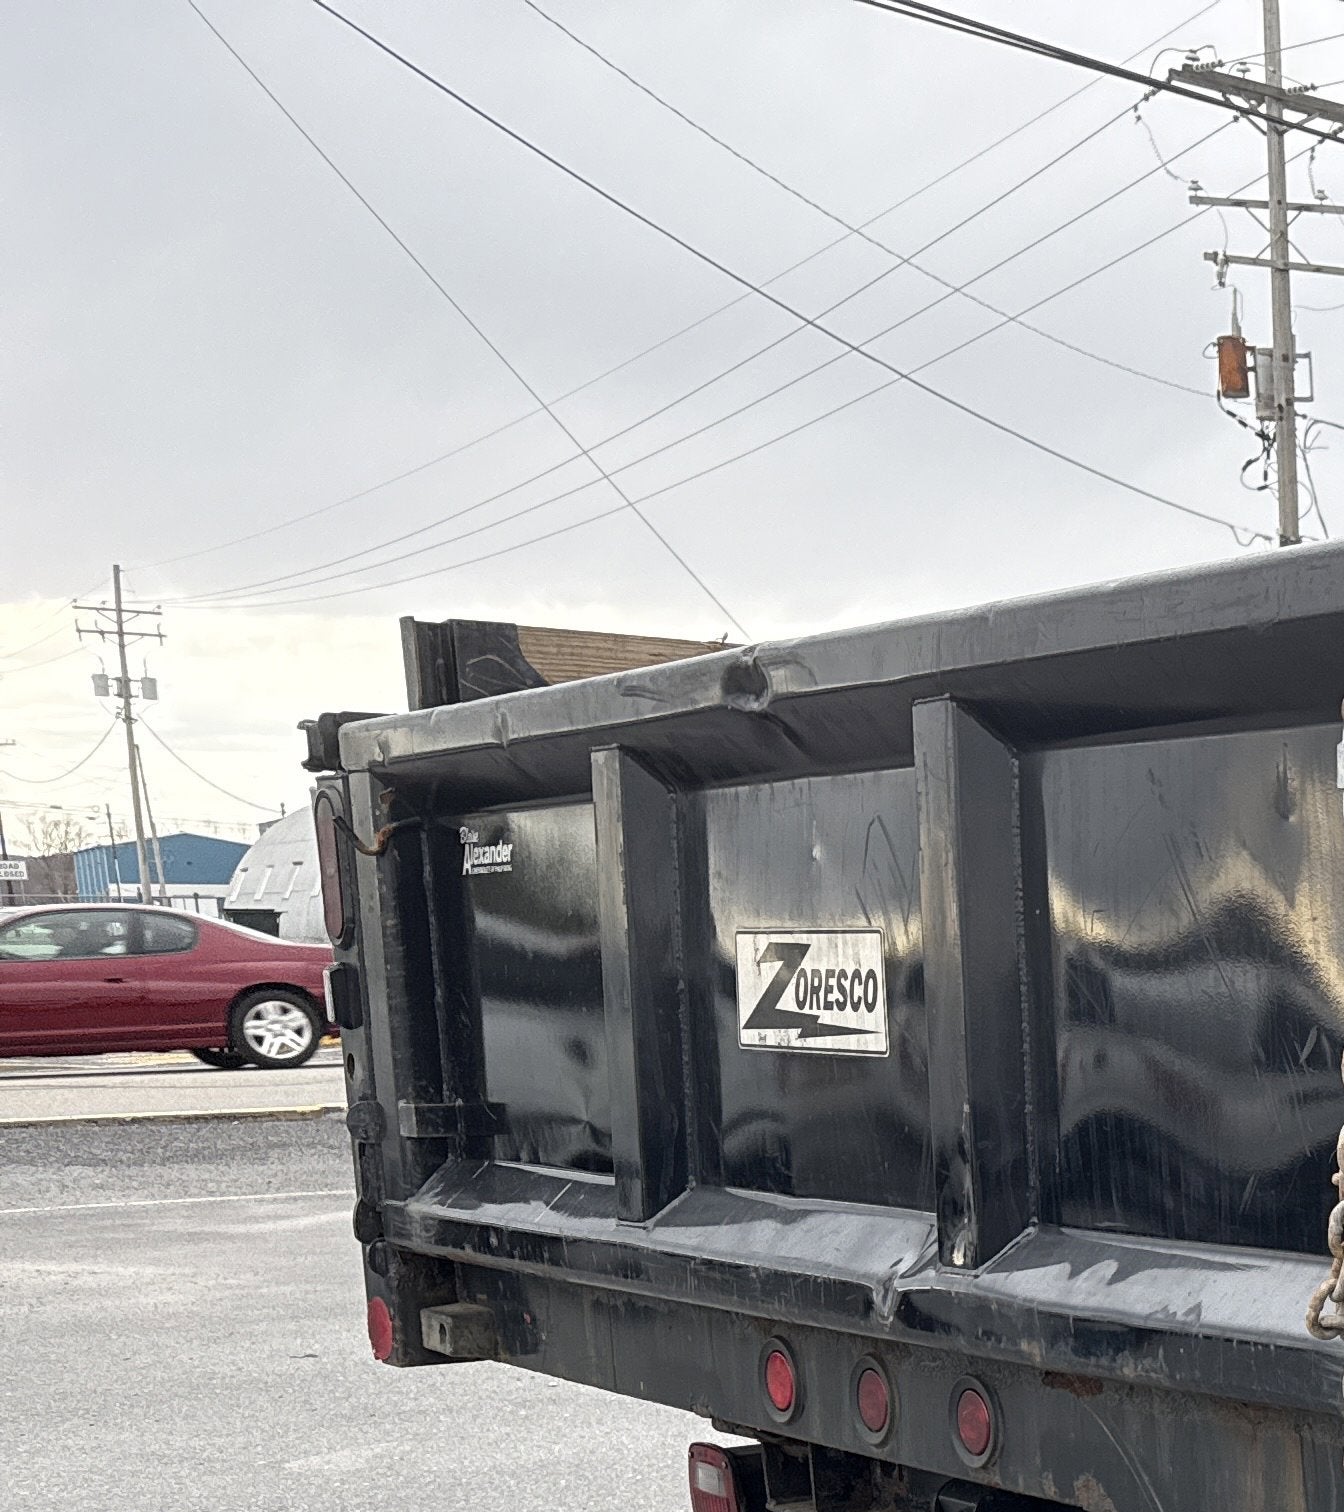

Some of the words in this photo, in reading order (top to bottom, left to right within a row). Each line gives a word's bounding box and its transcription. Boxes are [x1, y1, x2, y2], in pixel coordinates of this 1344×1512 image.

[0, 870, 25, 878] LOSED
[462, 839, 513, 876] Alexander
[742, 941, 883, 1040] ZORESCO
